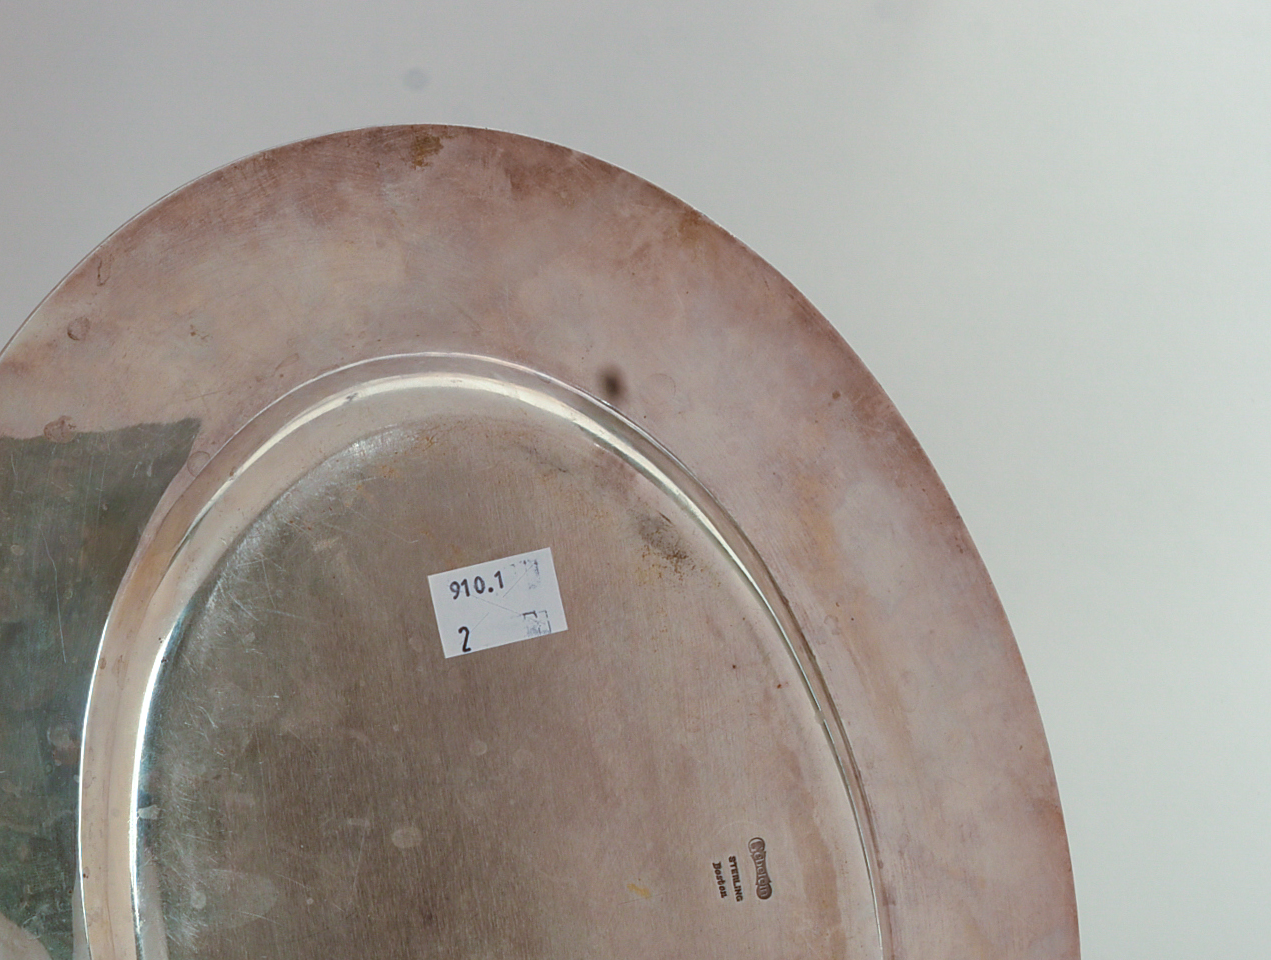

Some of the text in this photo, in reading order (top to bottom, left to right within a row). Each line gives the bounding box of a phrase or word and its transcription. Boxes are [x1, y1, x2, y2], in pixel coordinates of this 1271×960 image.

[449, 570, 504, 600] 910.1
[458, 626, 472, 652] 2
[712, 861, 727, 898] Boston
[728, 855, 743, 902] STERLING
